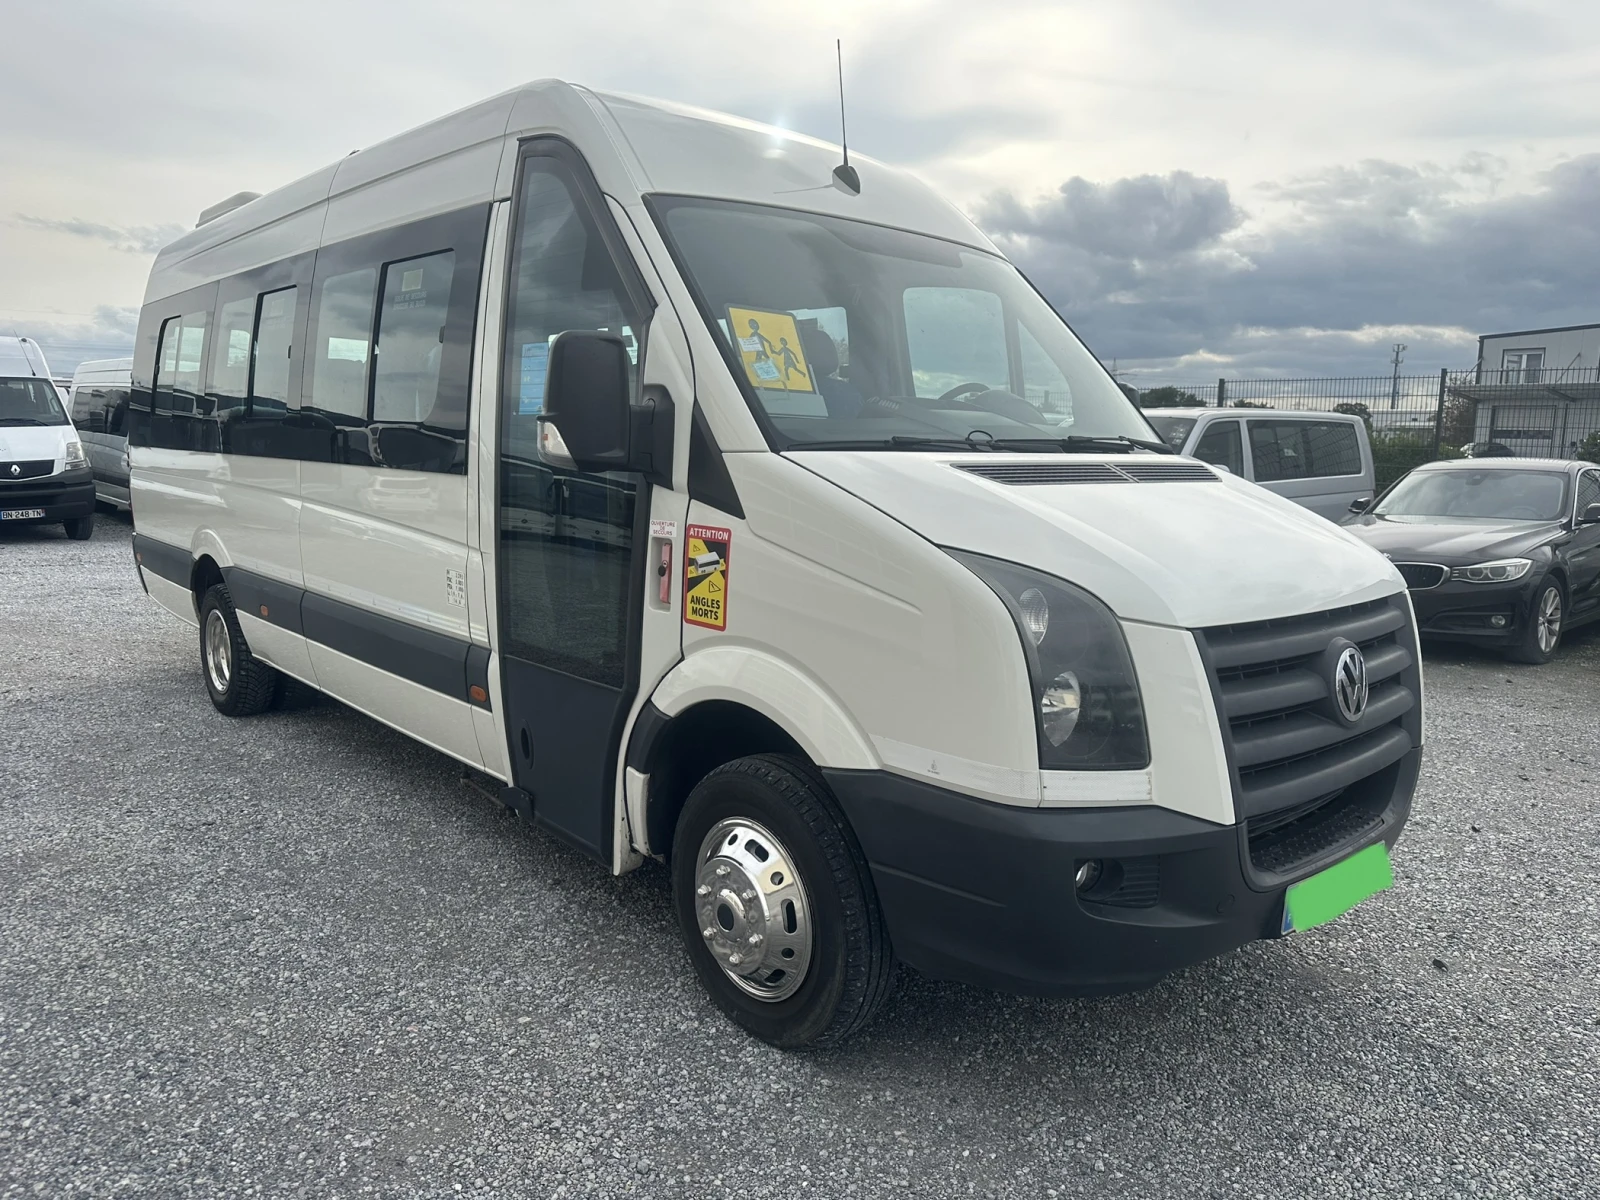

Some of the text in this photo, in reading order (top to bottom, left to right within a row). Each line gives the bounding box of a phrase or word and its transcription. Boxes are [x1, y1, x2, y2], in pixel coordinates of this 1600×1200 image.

[689, 527, 729, 541] ATTENTION
[690, 595, 721, 610] ANGLES
[691, 606, 719, 621] MORTS
